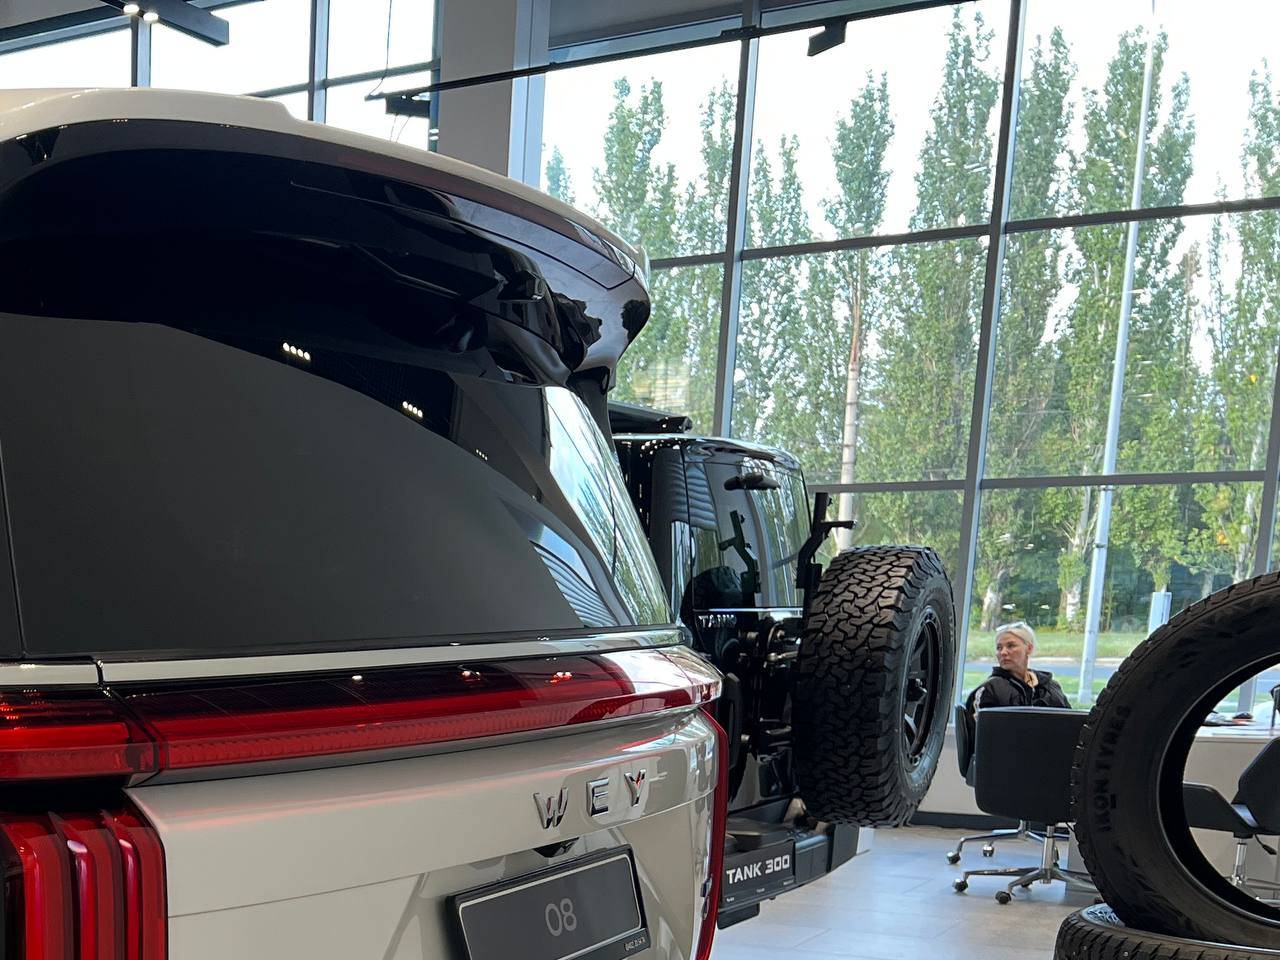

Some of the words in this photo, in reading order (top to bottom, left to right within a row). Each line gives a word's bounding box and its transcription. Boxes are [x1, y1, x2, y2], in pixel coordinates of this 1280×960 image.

[698, 614, 737, 628] TANK
[532, 769, 647, 829] WEY
[726, 862, 763, 885] TANK
[765, 854, 791, 875] 300
[545, 898, 577, 937] 08
